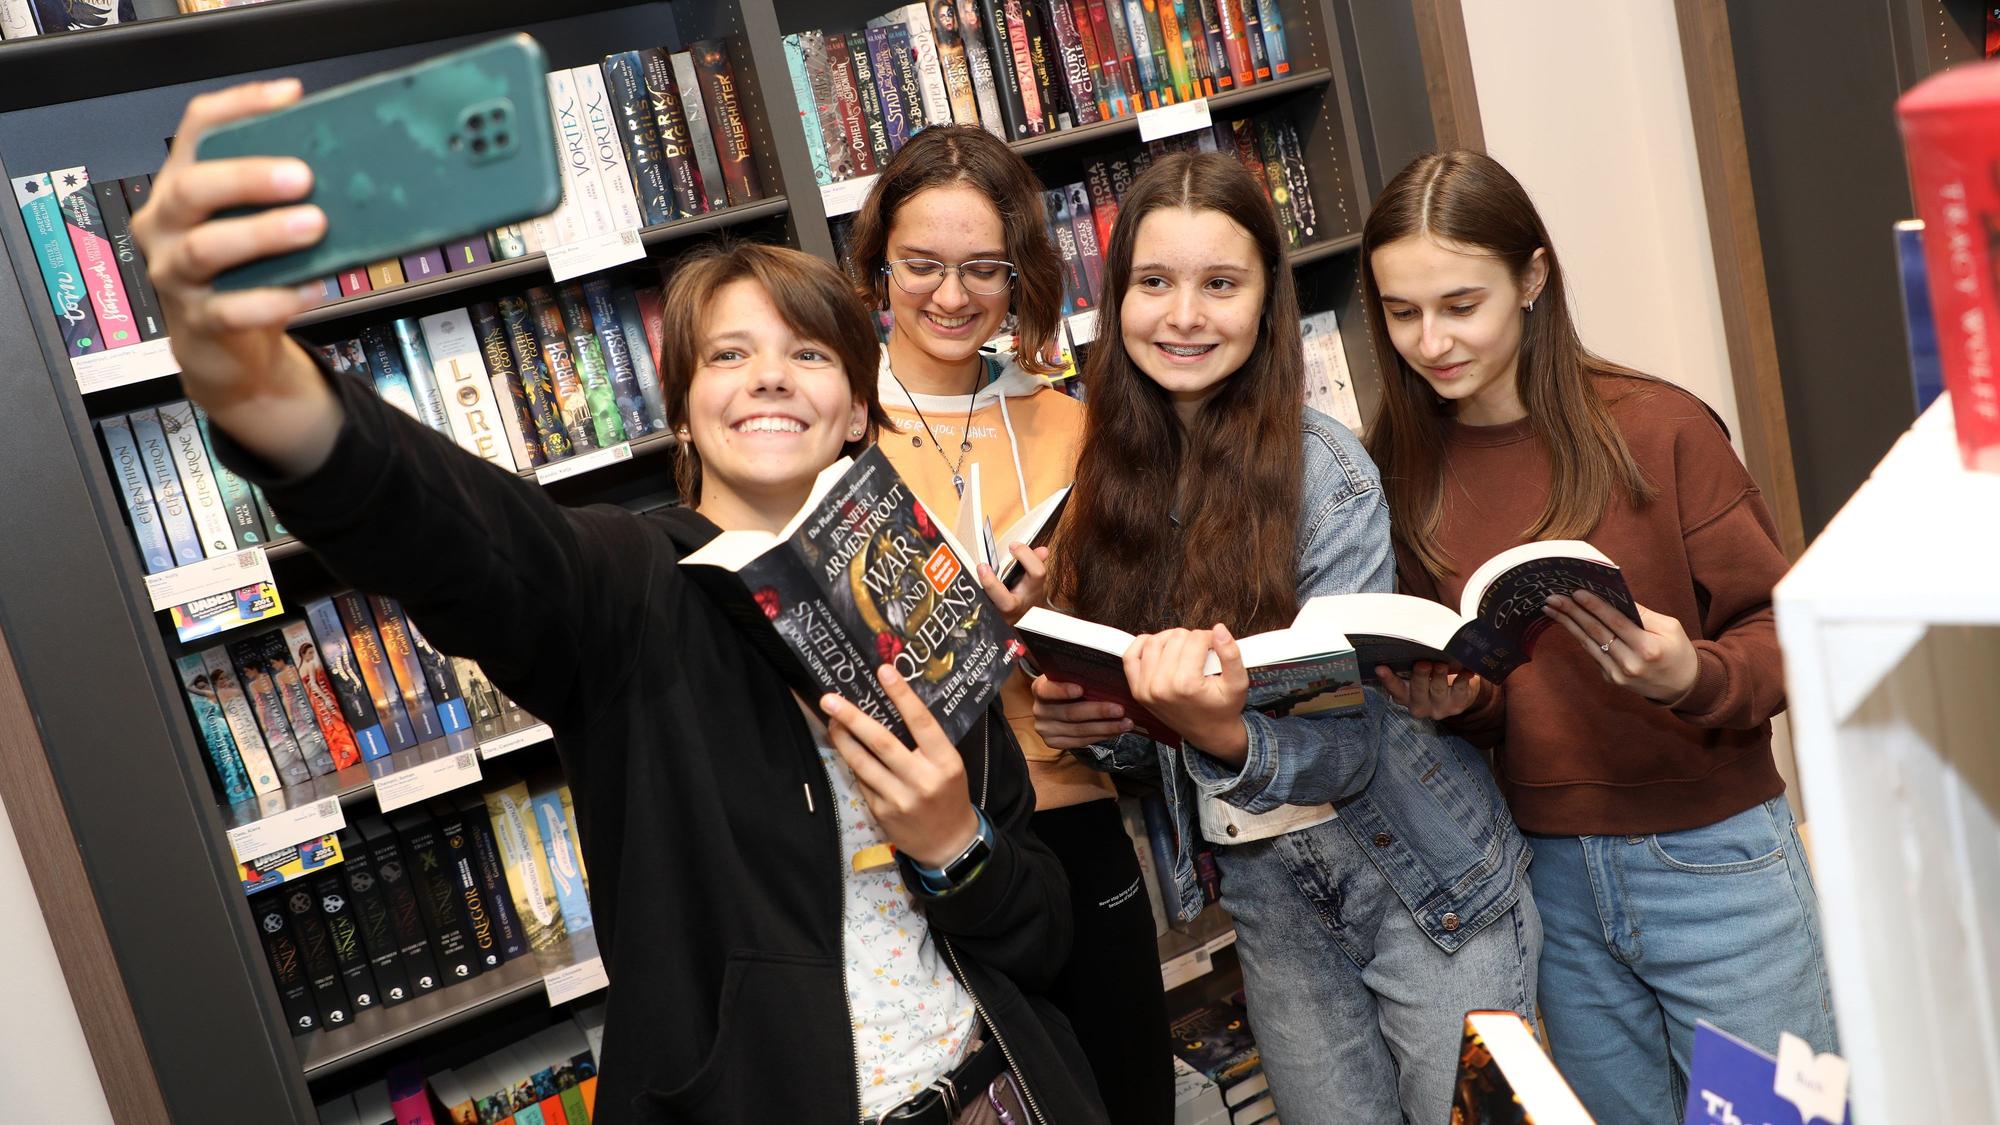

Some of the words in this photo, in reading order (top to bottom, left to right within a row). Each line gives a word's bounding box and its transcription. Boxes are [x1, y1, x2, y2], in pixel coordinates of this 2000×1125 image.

[853, 49, 872, 81] BUCH
[917, 33, 936, 75] BLOOD
[955, 54, 972, 95] STORM
[979, 49, 994, 89] STORM
[1062, 44, 1083, 84] RUBY
[1073, 42, 1093, 93] CIRCLE
[717, 73, 750, 160] FEUERHÜTER
[881, 85, 903, 122] STADT
[929, 81, 947, 122] CEPTER
[554, 95, 593, 179] VORTEX
[582, 90, 620, 173] VORTEX
[652, 96, 680, 158] DARK
[665, 93, 691, 155] SIGILS
[845, 113, 866, 151] OPHELIA
[868, 120, 888, 152] EMMA
[29, 200, 47, 236] JOSEPHINE
[37, 201, 53, 233] ANGELINI
[68, 193, 86, 230] JOSEPHINE
[74, 194, 91, 227] ANGELINI
[1055, 226, 1072, 261] ENGELS
[1064, 228, 1077, 256] LICHT
[1076, 221, 1092, 256] ENGELS
[1938, 181, 1981, 297] TRACY
[508, 316, 538, 372] PANTHER
[522, 329, 539, 358] GOTT
[574, 331, 607, 390] DARESH
[601, 324, 634, 383] DARESH
[1957, 305, 2000, 421] WOLFF
[544, 339, 579, 398] DARESH
[449, 357, 498, 460] LORE
[930, 423, 954, 436] YOU
[233, 504, 247, 526] HOLLY
[239, 502, 254, 525] BLACK
[824, 483, 904, 582] ARMENTROUT
[830, 499, 872, 548] JENNIFER
[861, 535, 920, 595] WAR
[901, 580, 928, 617] AND
[813, 599, 846, 641] GRENZEN
[893, 574, 976, 682] QUEENS
[782, 618, 836, 687] ARMENTROUT
[791, 601, 856, 683] QUEENS
[844, 641, 865, 668] KEINE
[861, 669, 886, 699] KENNT
[941, 669, 965, 700] LIEBE
[962, 638, 989, 672] KENNT
[942, 684, 968, 717] KEINE
[966, 642, 1000, 687] GRENZEN
[974, 680, 993, 704] ROMAN
[200, 705, 235, 765] SELECTION
[462, 885, 497, 950] GREGOR
